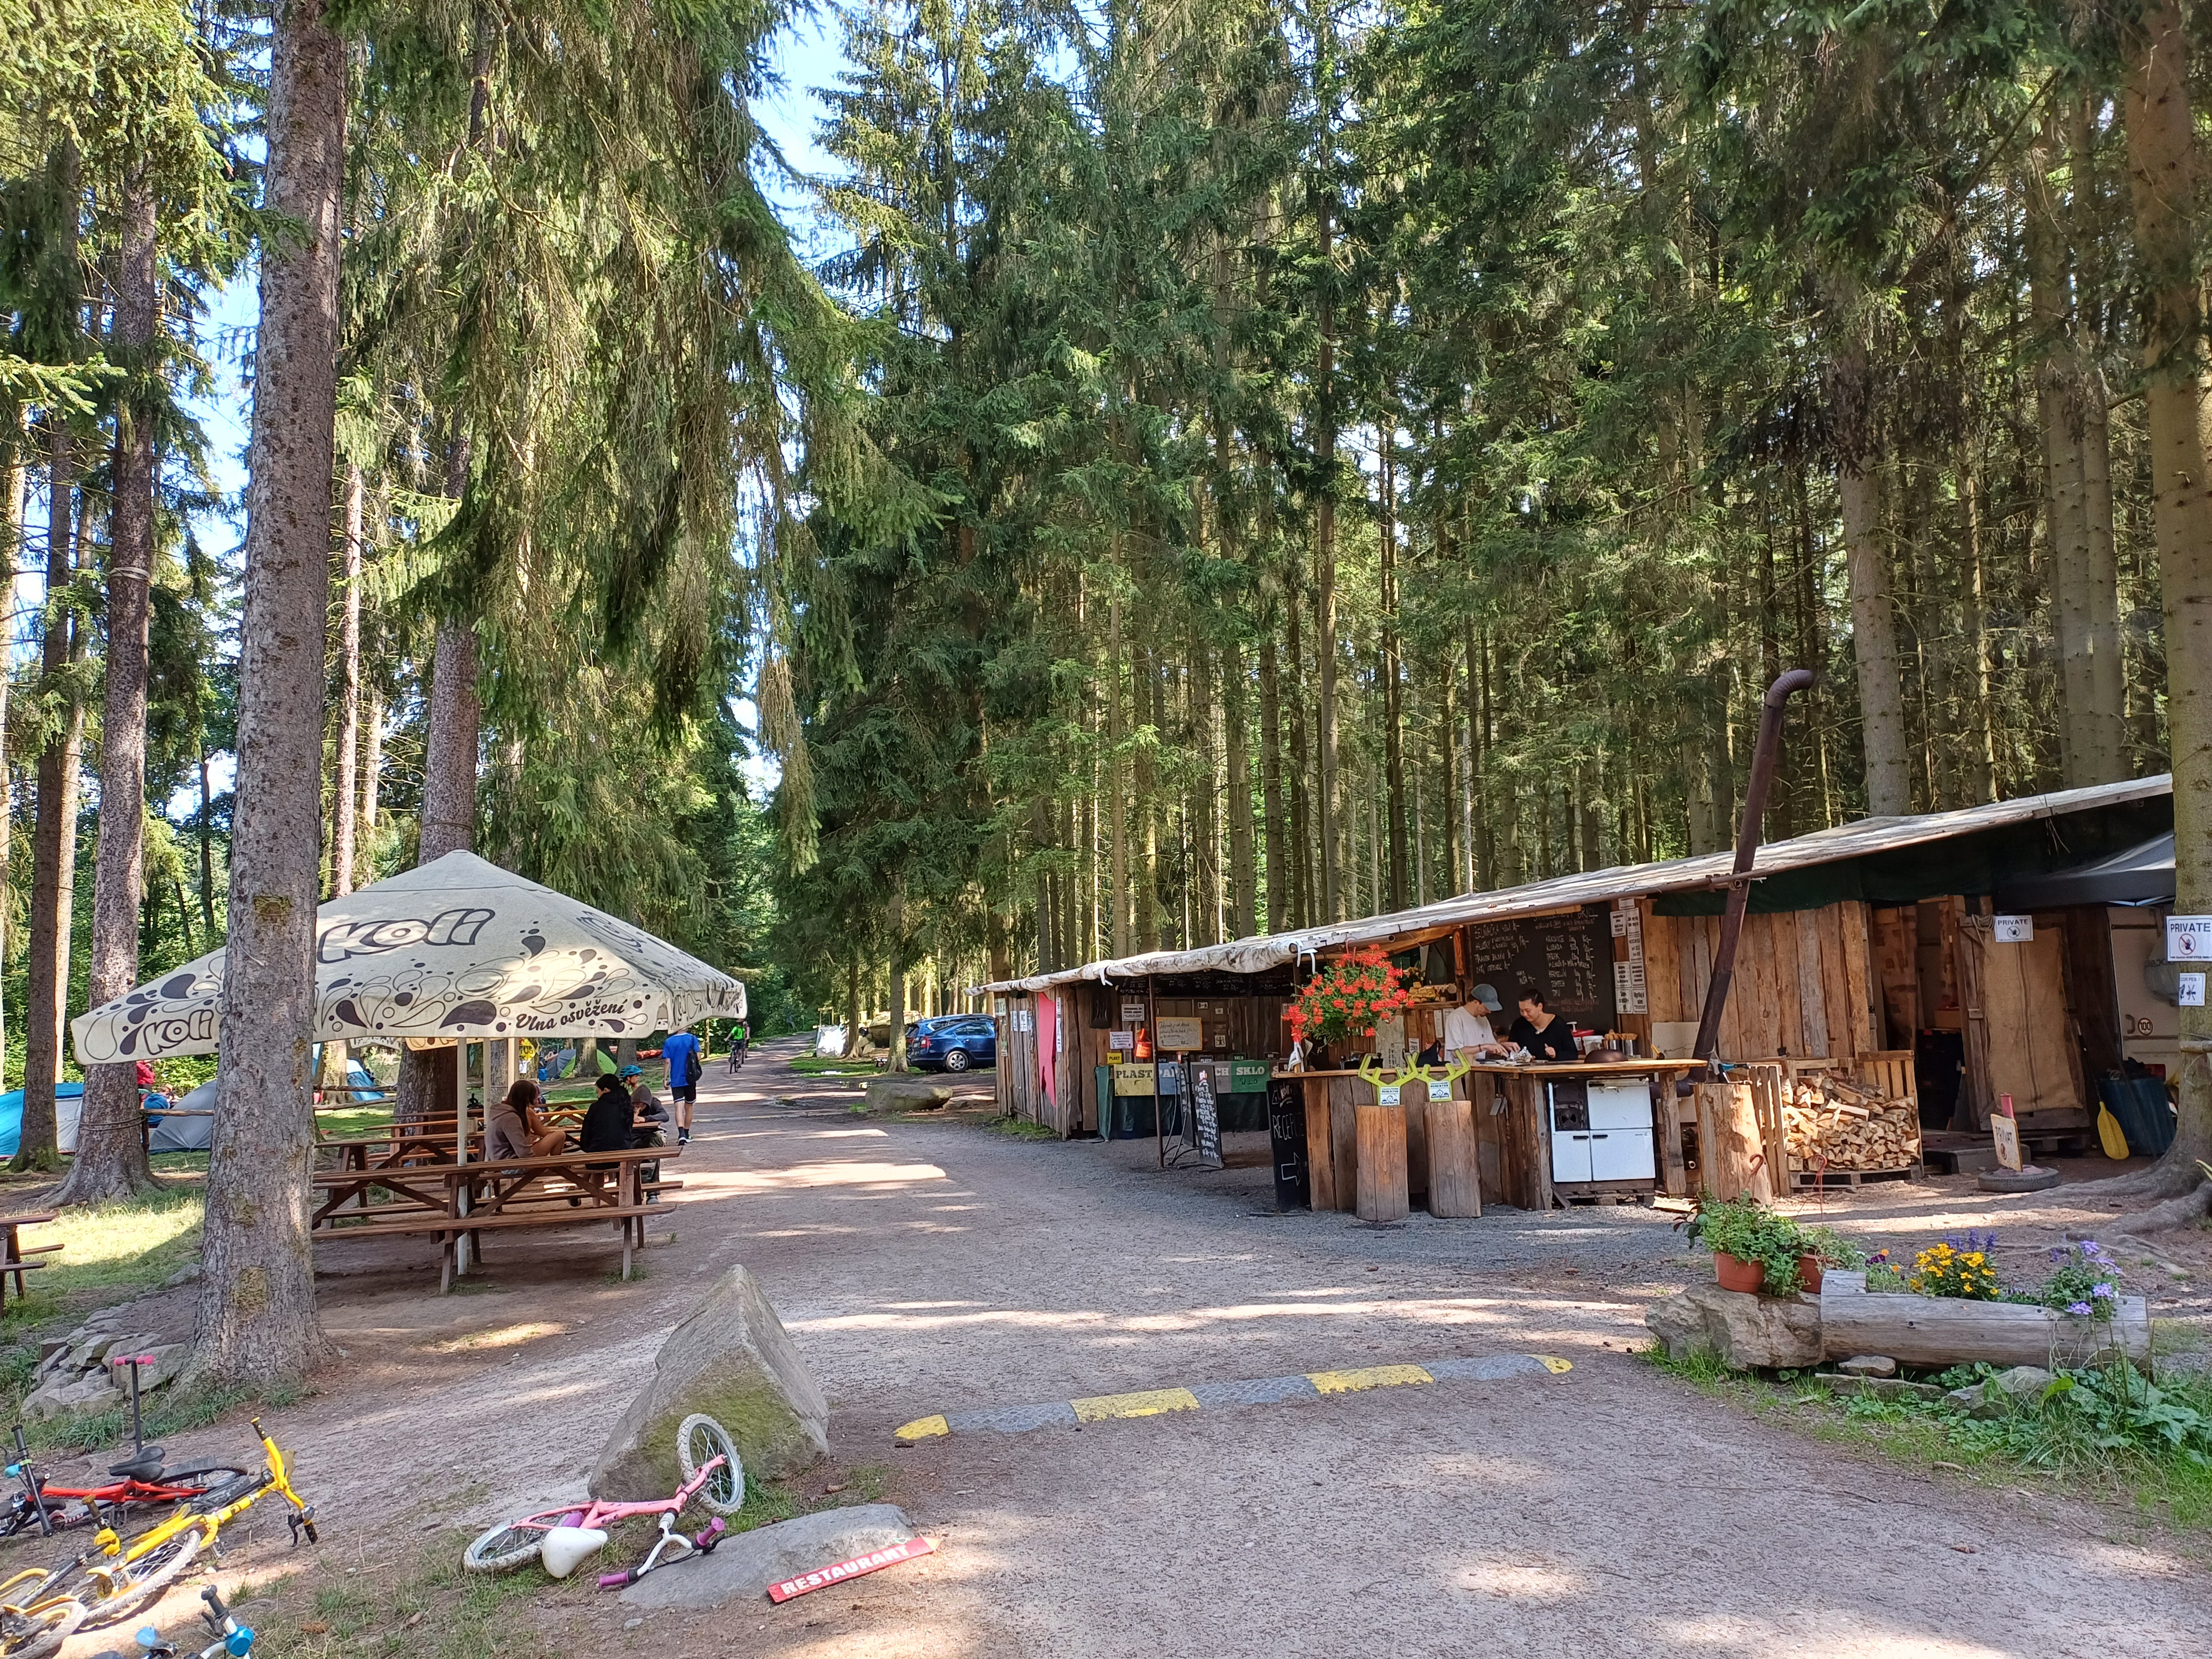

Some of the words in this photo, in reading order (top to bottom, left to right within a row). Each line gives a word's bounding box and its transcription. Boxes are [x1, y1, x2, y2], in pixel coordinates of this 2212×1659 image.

[2171, 923, 2210, 932] PRIVATE
[516, 1014, 557, 1030] Vlna
[560, 999, 628, 1025] osvěžení
[2140, 1021, 2151, 1031] 100
[1116, 1070, 1152, 1078] PLAST
[1236, 1066, 1265, 1076] SKLO
[780, 1546, 909, 1595] RESTAURANT
